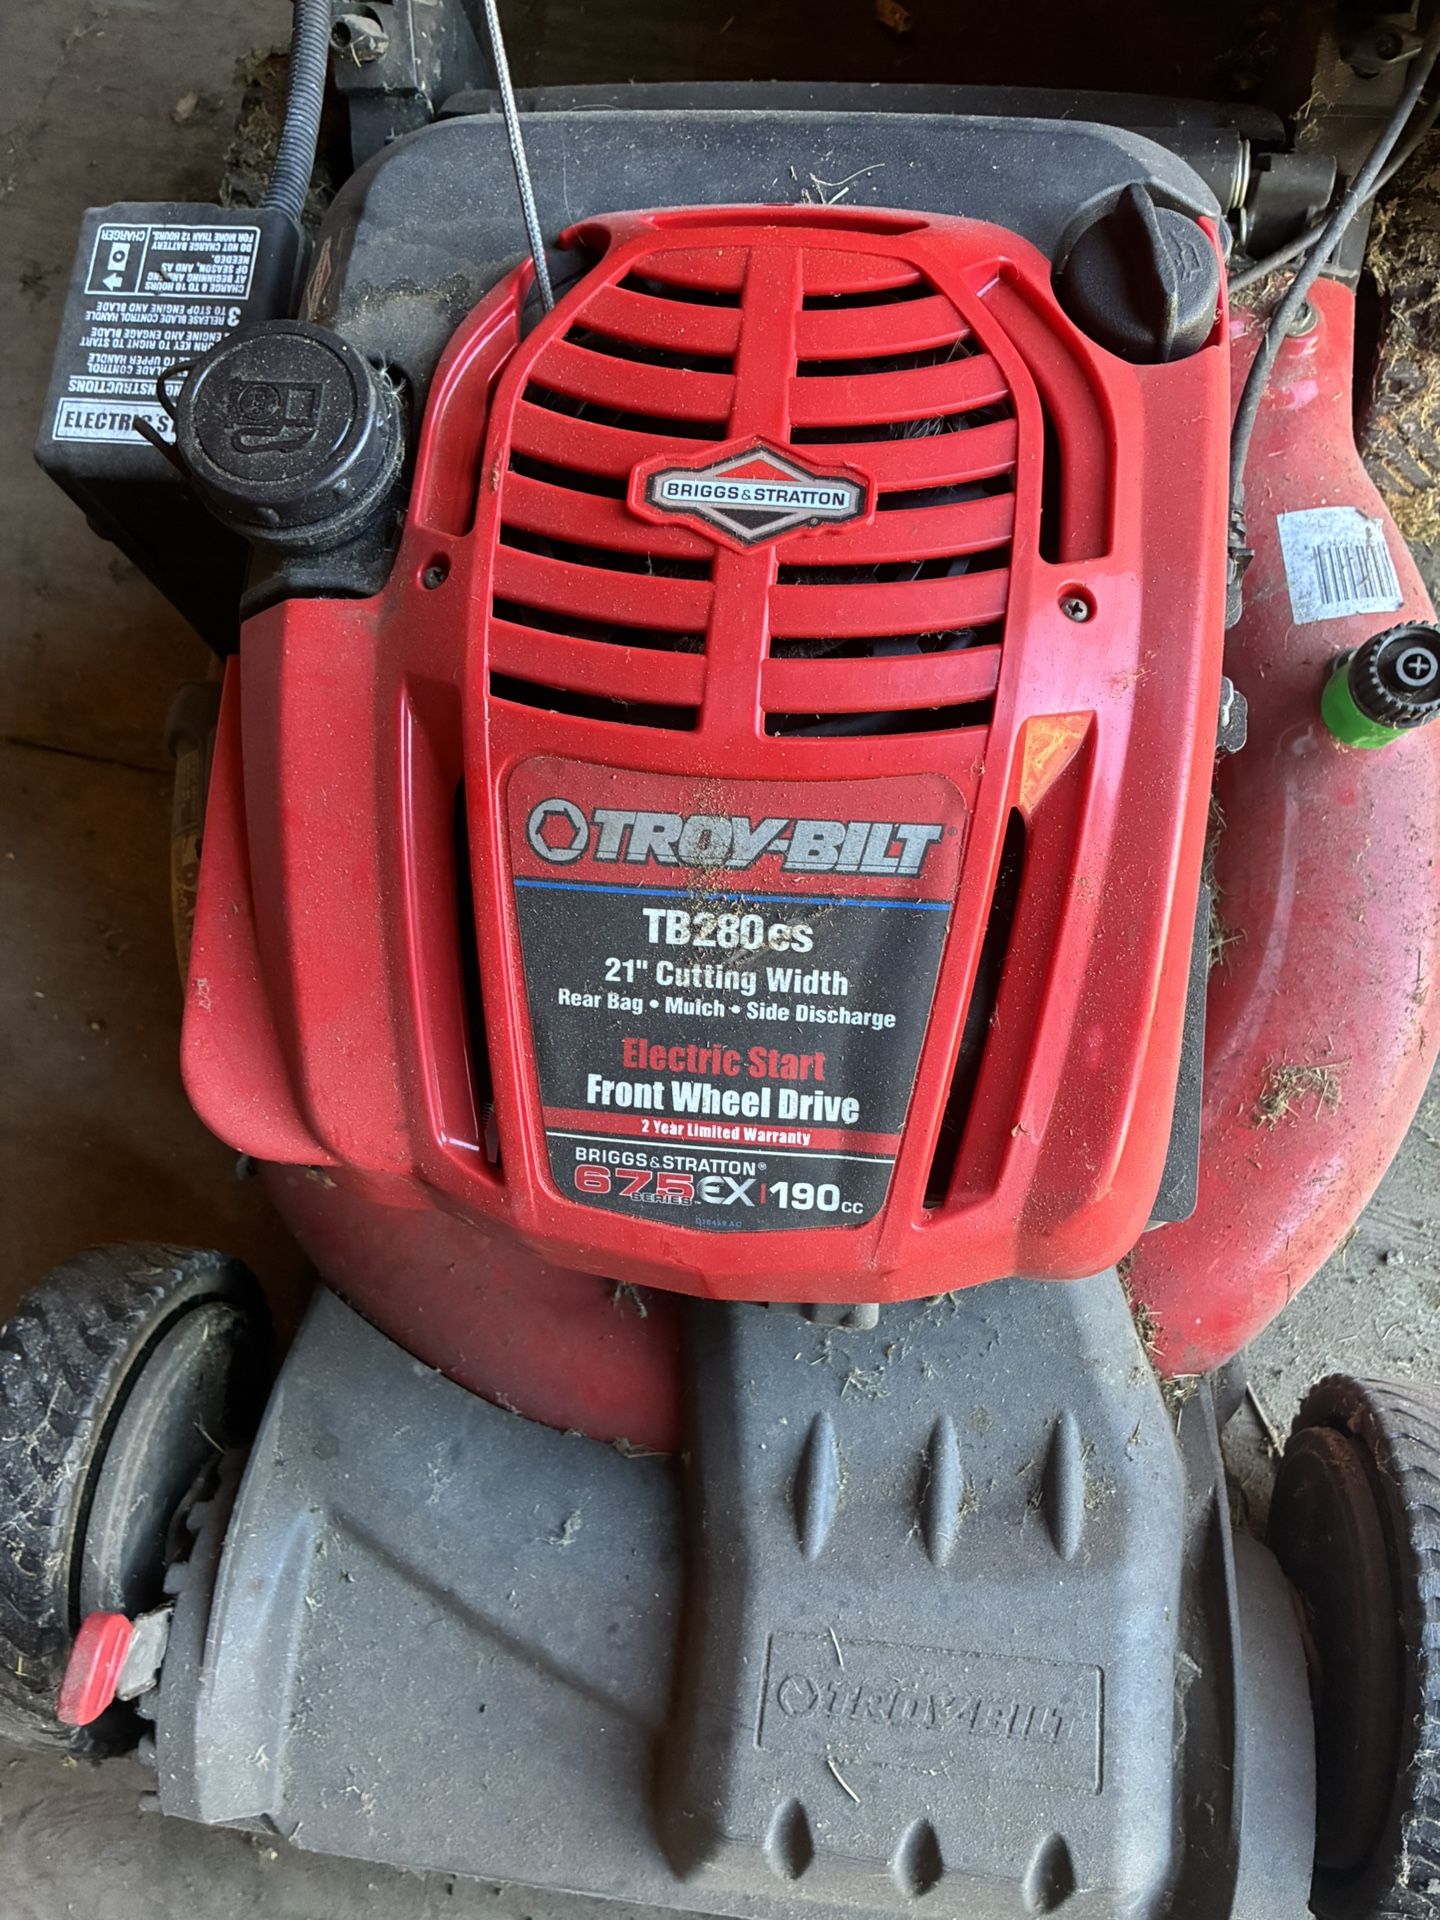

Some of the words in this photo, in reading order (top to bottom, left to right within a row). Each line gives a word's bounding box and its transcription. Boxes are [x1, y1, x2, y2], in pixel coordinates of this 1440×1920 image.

[101, 230, 145, 241] CHARGER
[152, 231, 180, 240] HOURS.
[182, 232, 190, 241] 12
[192, 233, 212, 241] THAN
[214, 233, 237, 241] MORE
[238, 233, 254, 242] FOR
[152, 241, 188, 250] BATTERY
[190, 242, 221, 251] CHARGE
[223, 243, 239, 251] NOT
[242, 243, 252, 251] DO
[211, 255, 250, 264] NEEDED.
[161, 263, 174, 271] AS
[176, 263, 194, 272] AND
[197, 262, 234, 273] SEASON,
[235, 265, 248, 273] OF
[187, 273, 233, 282] BEGINNING
[235, 275, 247, 283] AT
[145, 281, 174, 291] HOURS
[176, 283, 186, 291] 10
[188, 283, 199, 292] TO
[210, 284, 244, 293] CHARGE
[96, 302, 127, 312] BLADE
[129, 303, 148, 313] AND
[151, 304, 185, 314] ENGINE
[187, 305, 212, 315] STOP
[214, 306, 226, 315] TO
[85, 311, 119, 322] HANDLE
[121, 313, 158, 323] CONTROL
[160, 314, 187, 324] BLADE
[188, 316, 225, 325] RELEASE
[228, 307, 241, 327] 3
[90, 328, 122, 338] BLADE
[124, 329, 161, 339] ENGAGE
[165, 331, 185, 340] AND
[186, 331, 222, 341] ENGINE
[80, 337, 110, 347] START
[113, 339, 125, 348] TO
[127, 340, 156, 349] RIGHT
[159, 341, 170, 350] TO
[174, 341, 191, 350] KEY
[88, 353, 127, 364] HANDLE
[130, 356, 160, 365] UPPER
[87, 363, 133, 374] CONTROL
[68, 380, 156, 395] NSTRUCTIONS
[64, 410, 152, 431] ELECTR
[667, 482, 846, 506] BRIGGS&STRATTON
[593, 808, 942, 877] TROY-BILT
[604, 957, 648, 983] 21"
[655, 959, 757, 996] Cutting
[766, 966, 848, 996] Width
[558, 988, 602, 1008] Rear
[607, 991, 643, 1015] Bag
[664, 996, 725, 1017] Mulch
[746, 1000, 789, 1021] Side
[796, 1004, 896, 1031] Discharge
[622, 1038, 740, 1077] Electric
[748, 1046, 826, 1081] Start
[587, 1073, 665, 1111] Front
[670, 1080, 771, 1118] Wheel
[778, 1088, 860, 1125] Drive
[641, 1119, 649, 1133] 2
[653, 1120, 684, 1138] Year
[687, 1123, 738, 1141] Limited
[743, 1127, 811, 1146] Warranty
[574, 1164, 695, 1199] 675
[696, 1175, 757, 1207] EX
[631, 1191, 693, 1207] SERIES
